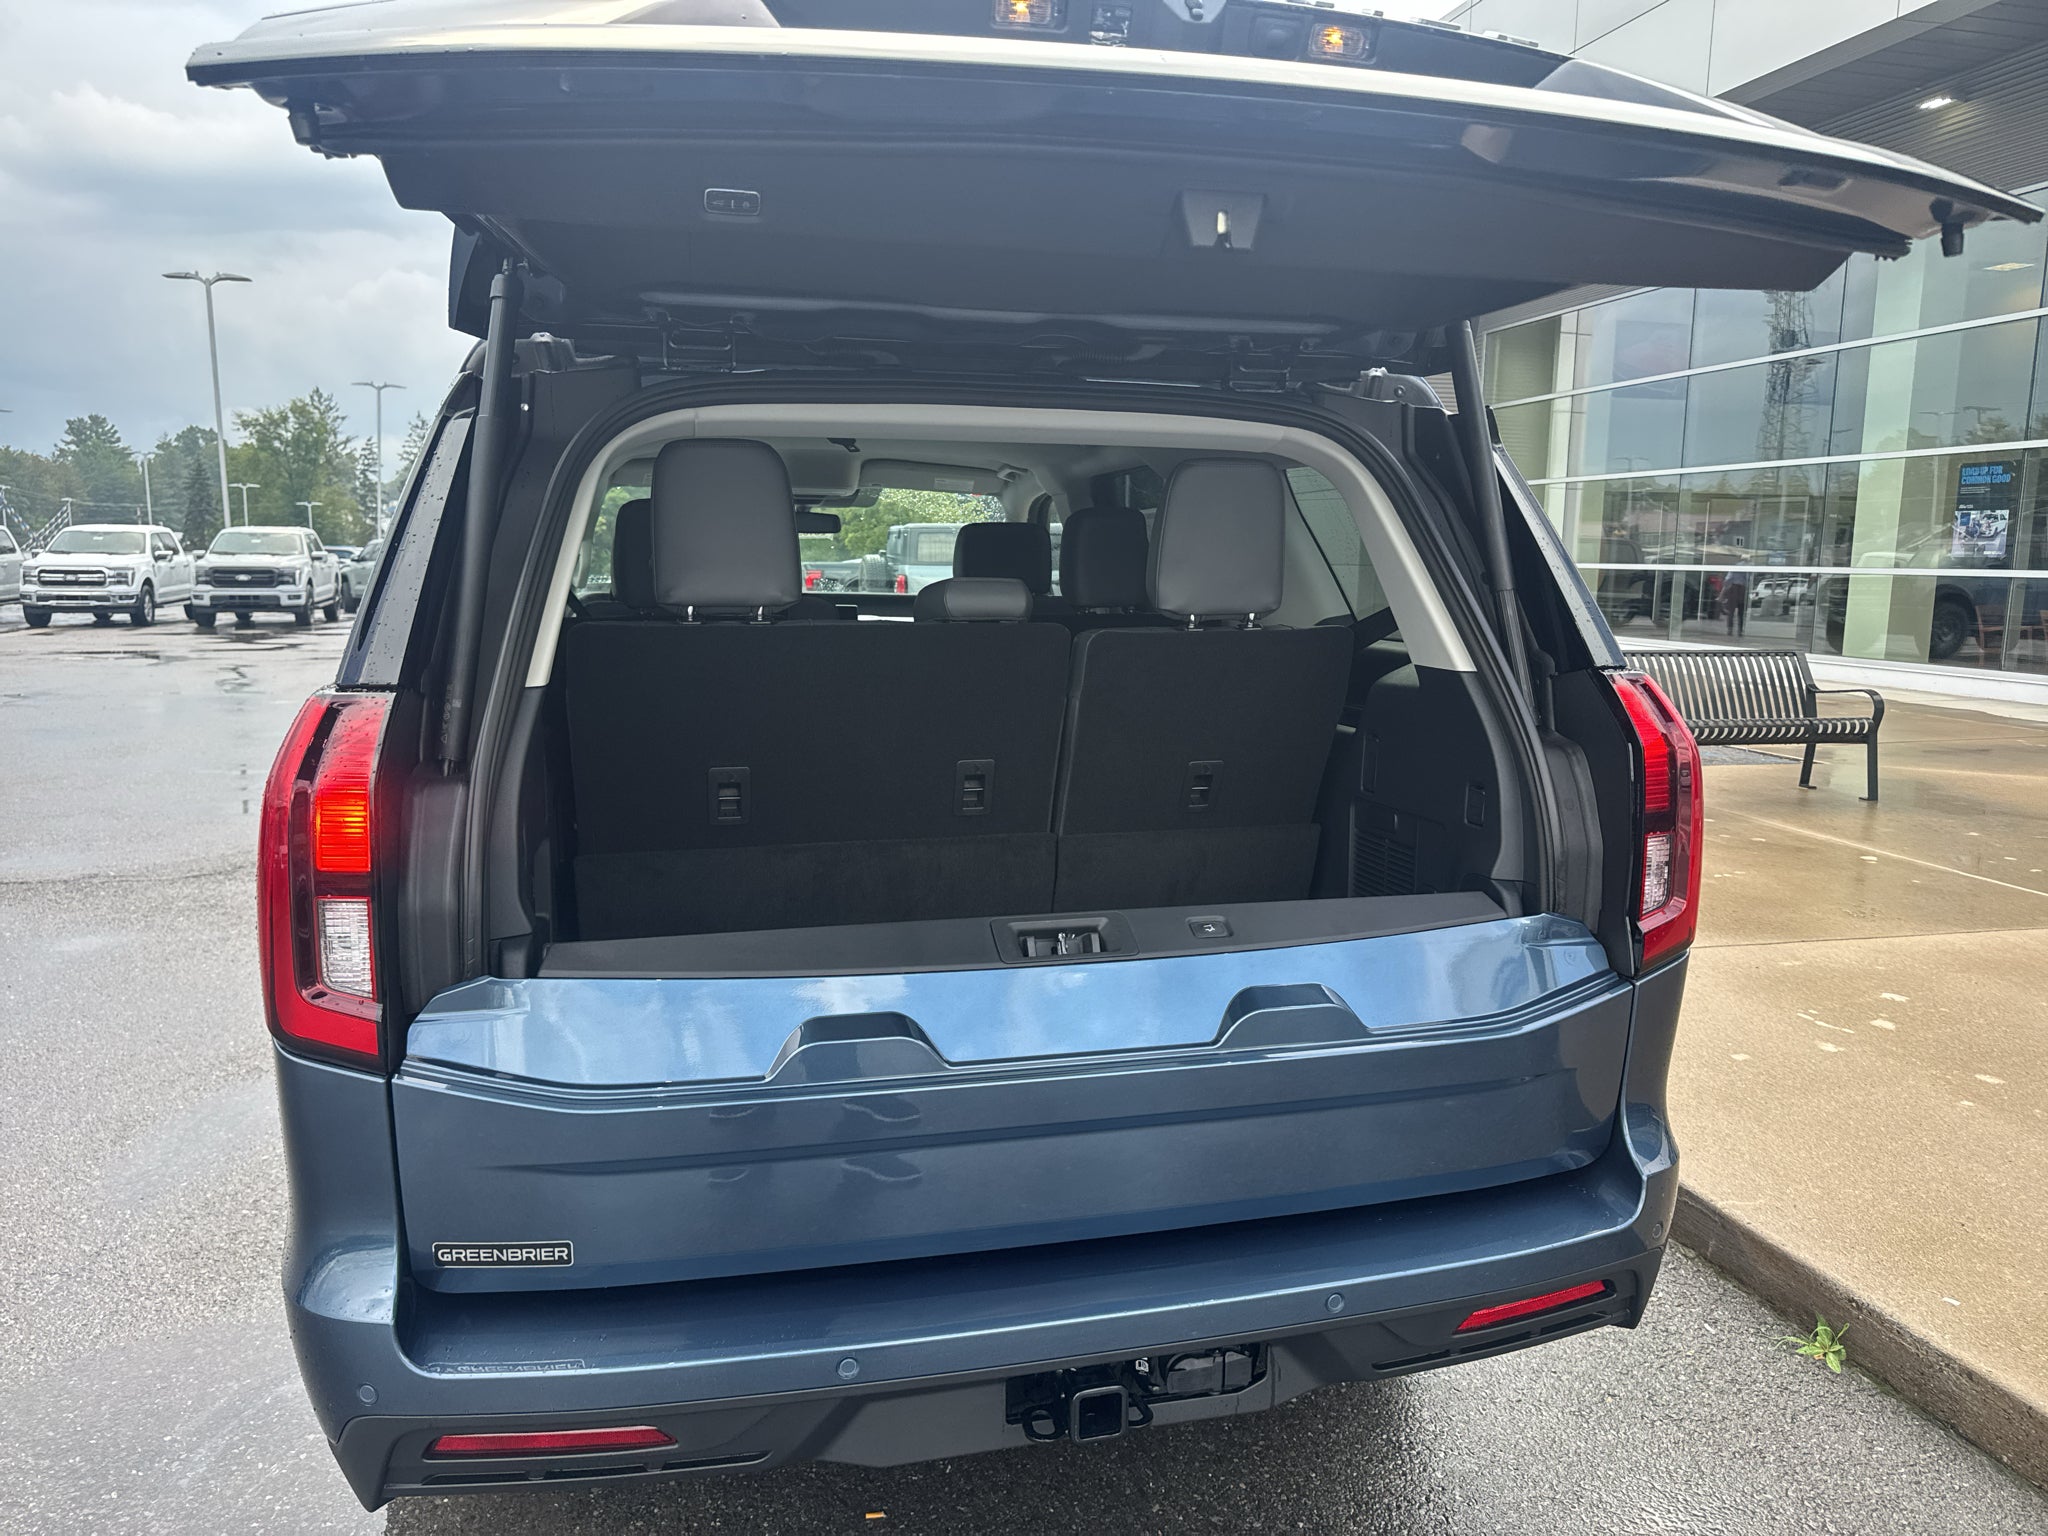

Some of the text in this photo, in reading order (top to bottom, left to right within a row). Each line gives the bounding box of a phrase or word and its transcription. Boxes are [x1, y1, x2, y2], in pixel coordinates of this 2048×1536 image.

[1990, 466, 2003, 474] FOR
[1962, 474, 2011, 484] COMMON GOOD
[438, 1248, 568, 1262] GREENBRIER
